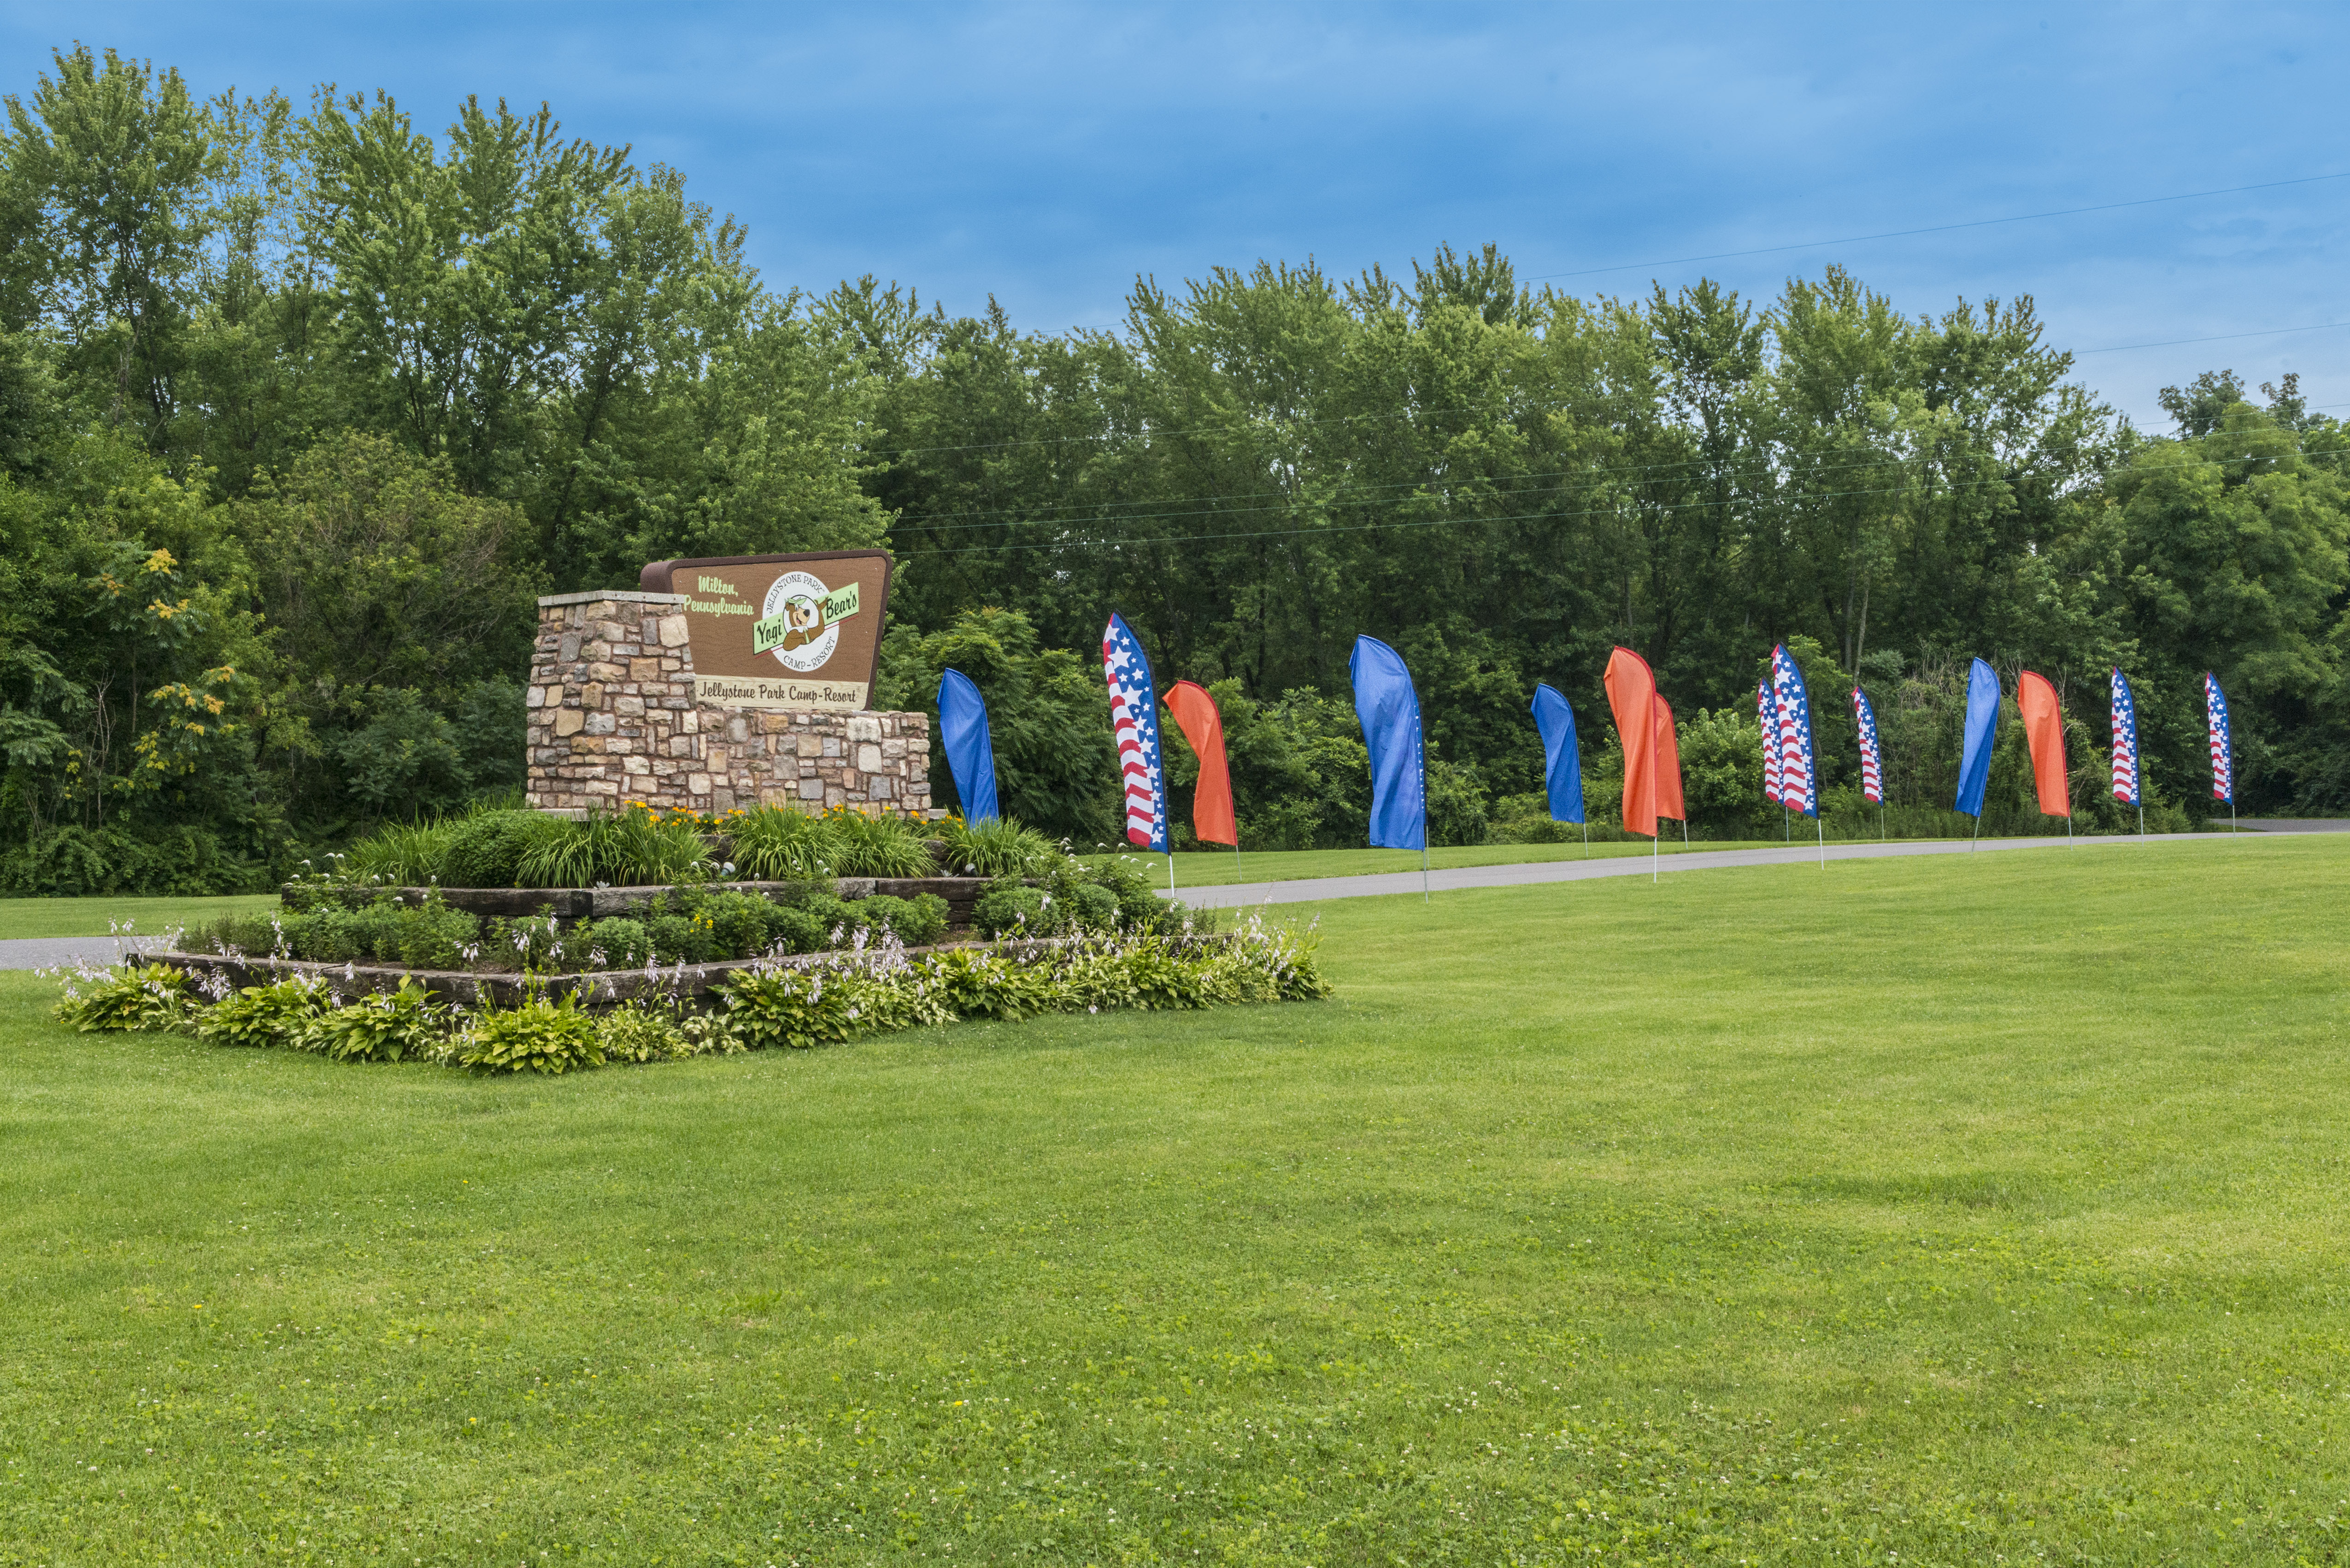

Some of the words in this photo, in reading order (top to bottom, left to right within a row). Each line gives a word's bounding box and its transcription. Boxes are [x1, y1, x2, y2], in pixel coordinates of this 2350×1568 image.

[698, 576, 739, 598] Milton,
[766, 574, 802, 614] JELLYSTONE
[684, 594, 755, 618] Pennsylvania
[757, 618, 782, 644] Yogi
[826, 591, 857, 620] Bear's
[699, 681, 756, 701] Jellystone
[758, 684, 786, 700] Park
